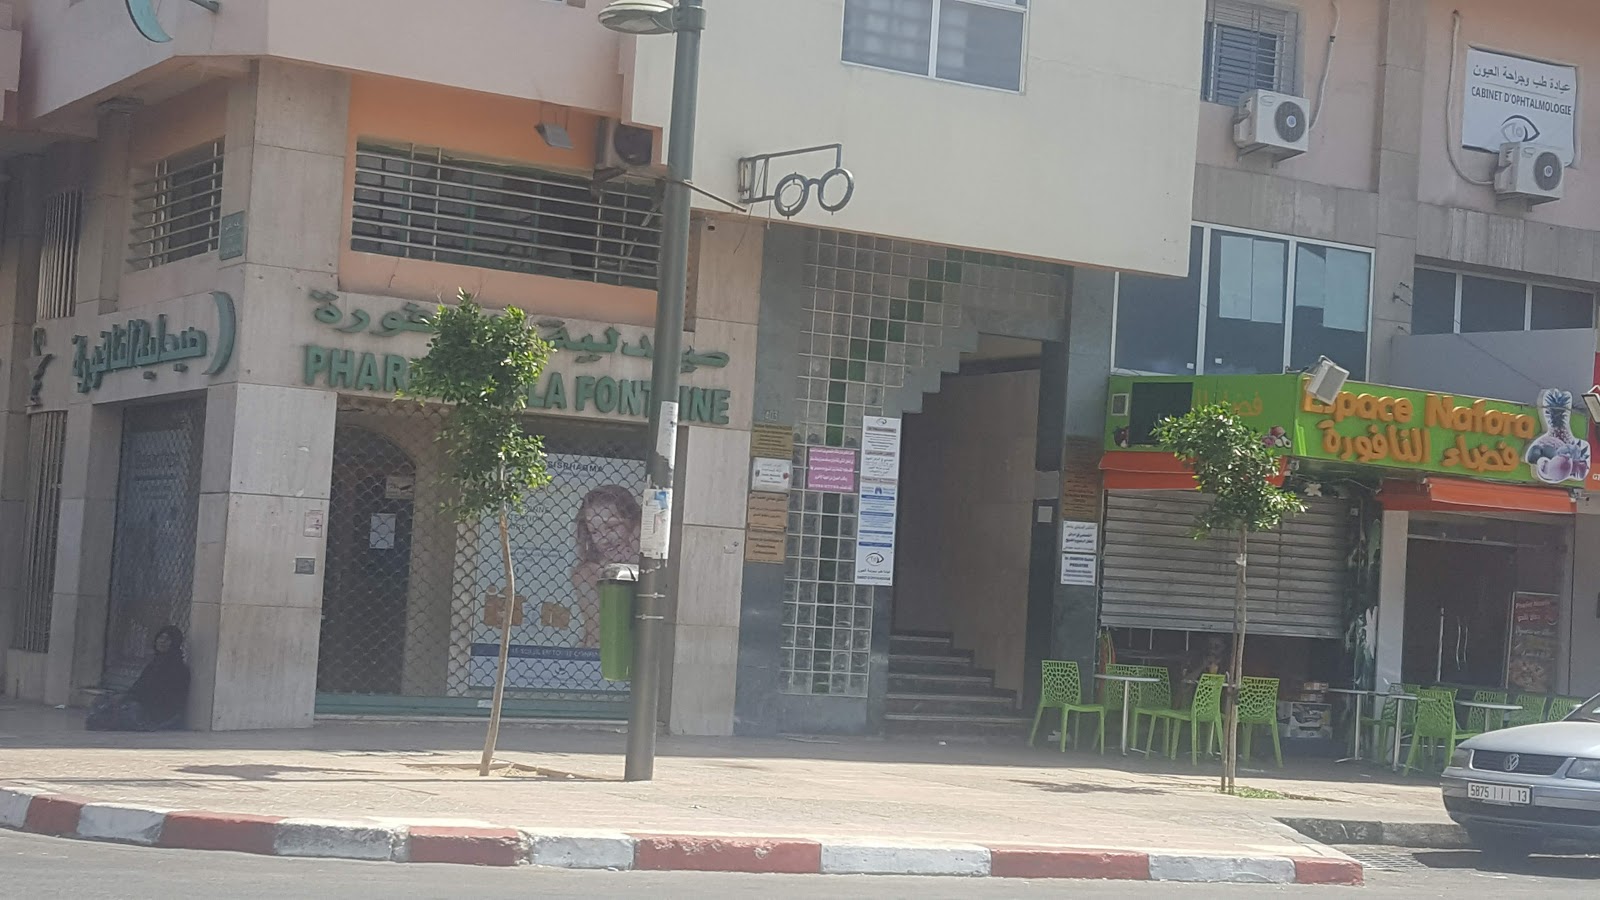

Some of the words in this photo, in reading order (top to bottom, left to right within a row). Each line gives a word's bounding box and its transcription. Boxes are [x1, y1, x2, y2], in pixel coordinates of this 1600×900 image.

[1472, 64, 1500, 79] العيون
[1502, 66, 1531, 87] وجراحة
[1532, 75, 1548, 90] طب
[1550, 78, 1571, 95] عيادة
[1471, 86, 1503, 101] CABINET
[1504, 92, 1572, 116] D'OPHTALMOLOGIE
[575, 375, 731, 425] FONTINE
[1425, 393, 1537, 440] Nafora
[1316, 420, 1432, 464] النافورة
[1441, 434, 1521, 472] فضاء
[1470, 785, 1490, 798] 5875
[1517, 790, 1527, 802] 13
